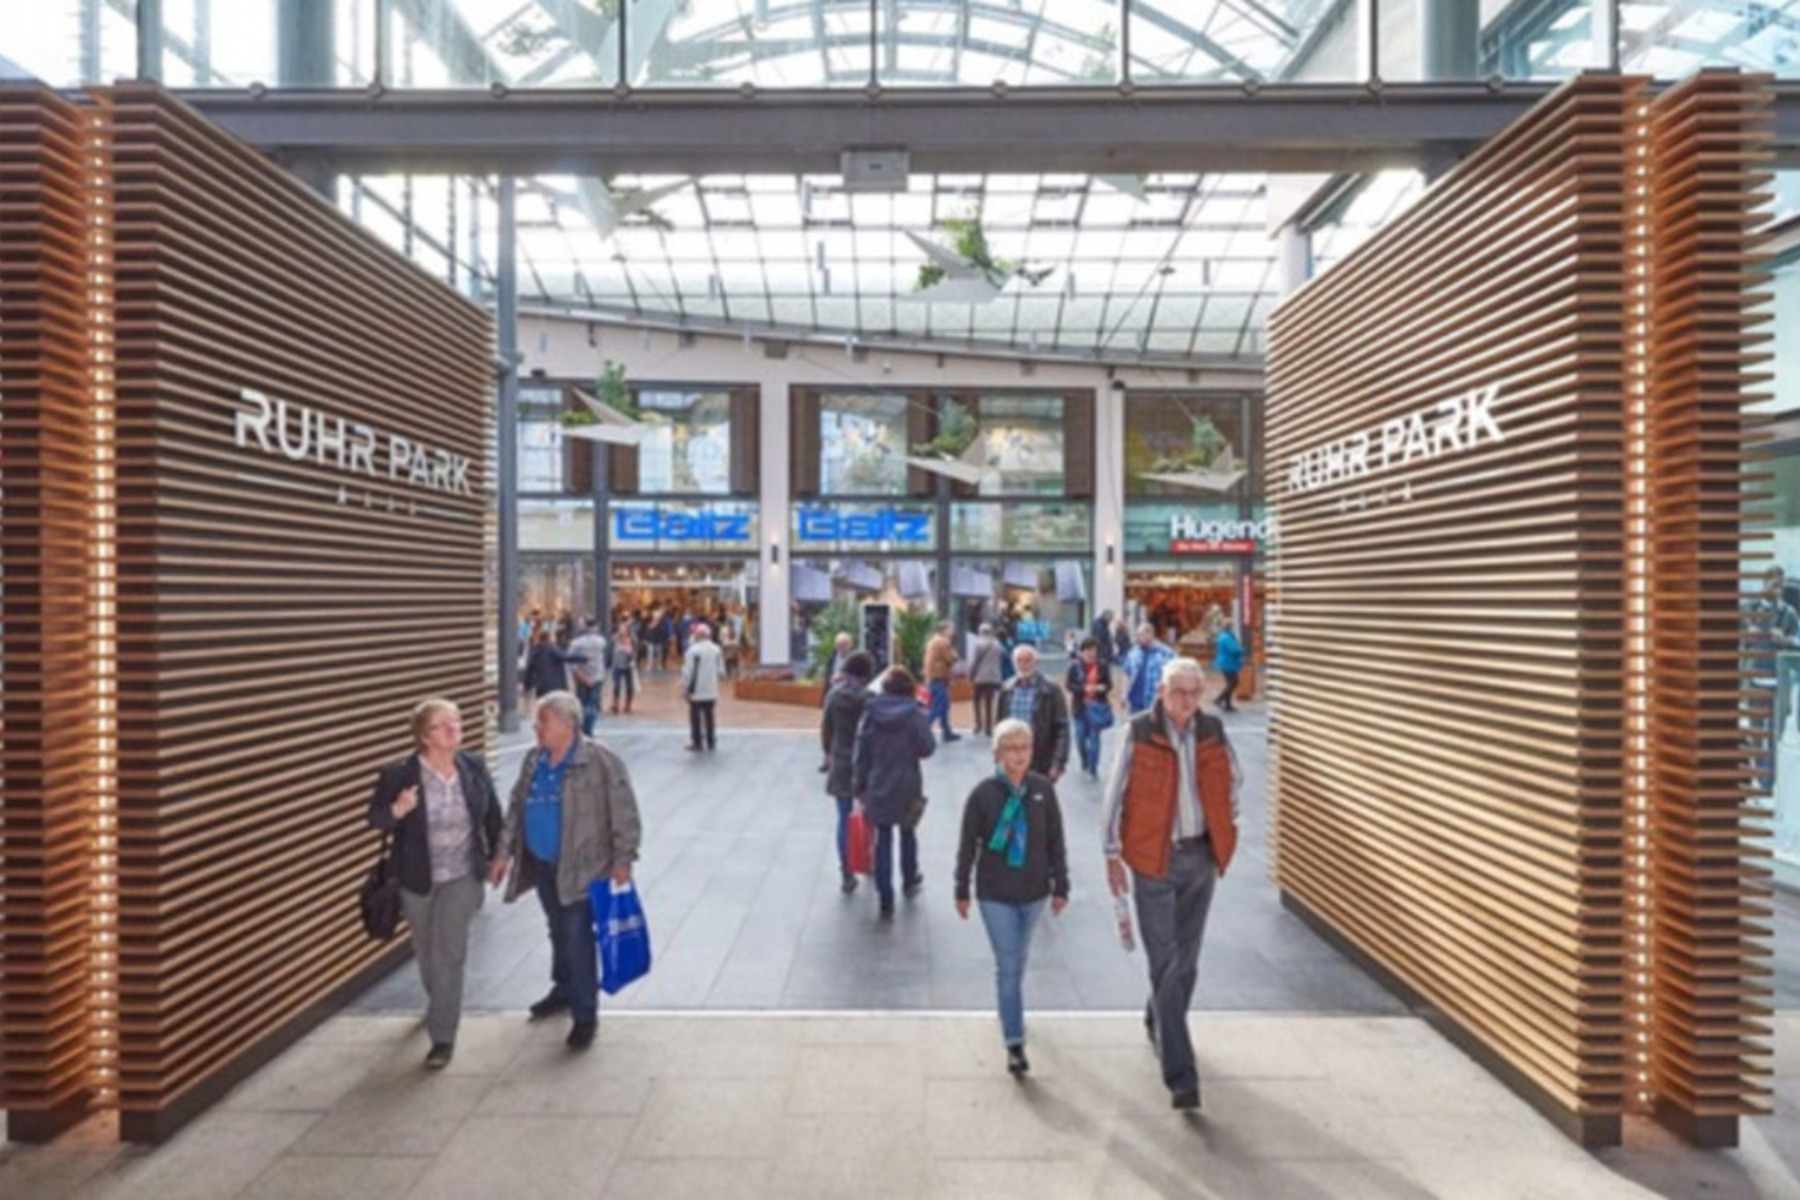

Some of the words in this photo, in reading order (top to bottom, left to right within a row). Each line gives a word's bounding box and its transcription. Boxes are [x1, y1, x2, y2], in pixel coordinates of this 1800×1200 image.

[235, 388, 376, 476] RUHR
[388, 434, 473, 496] PARK
[1381, 383, 1504, 468] PARK
